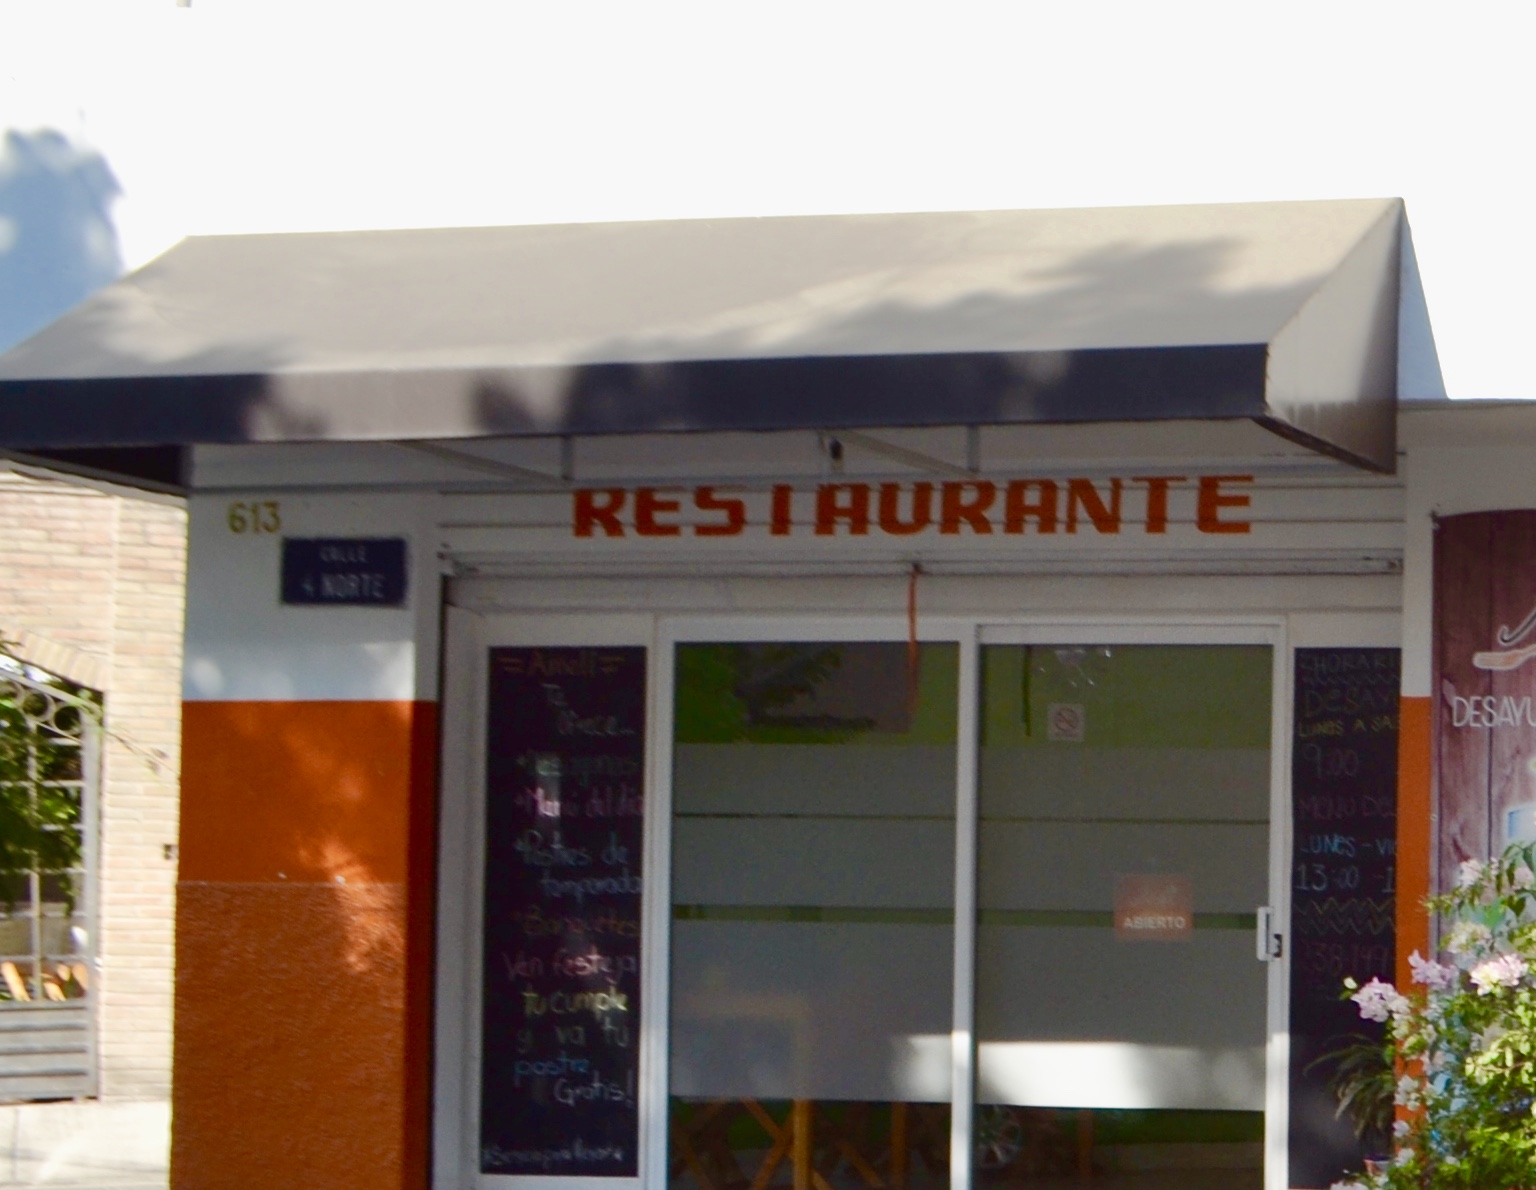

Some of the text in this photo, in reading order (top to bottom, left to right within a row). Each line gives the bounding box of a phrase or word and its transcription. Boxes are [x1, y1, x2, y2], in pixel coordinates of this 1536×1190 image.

[227, 501, 281, 535] 613
[573, 475, 1254, 538] RESTAURANTE
[320, 572, 386, 599] NORTE
[1314, 653, 1397, 674] HORARI
[1123, 916, 1187, 930] ABIERTO
